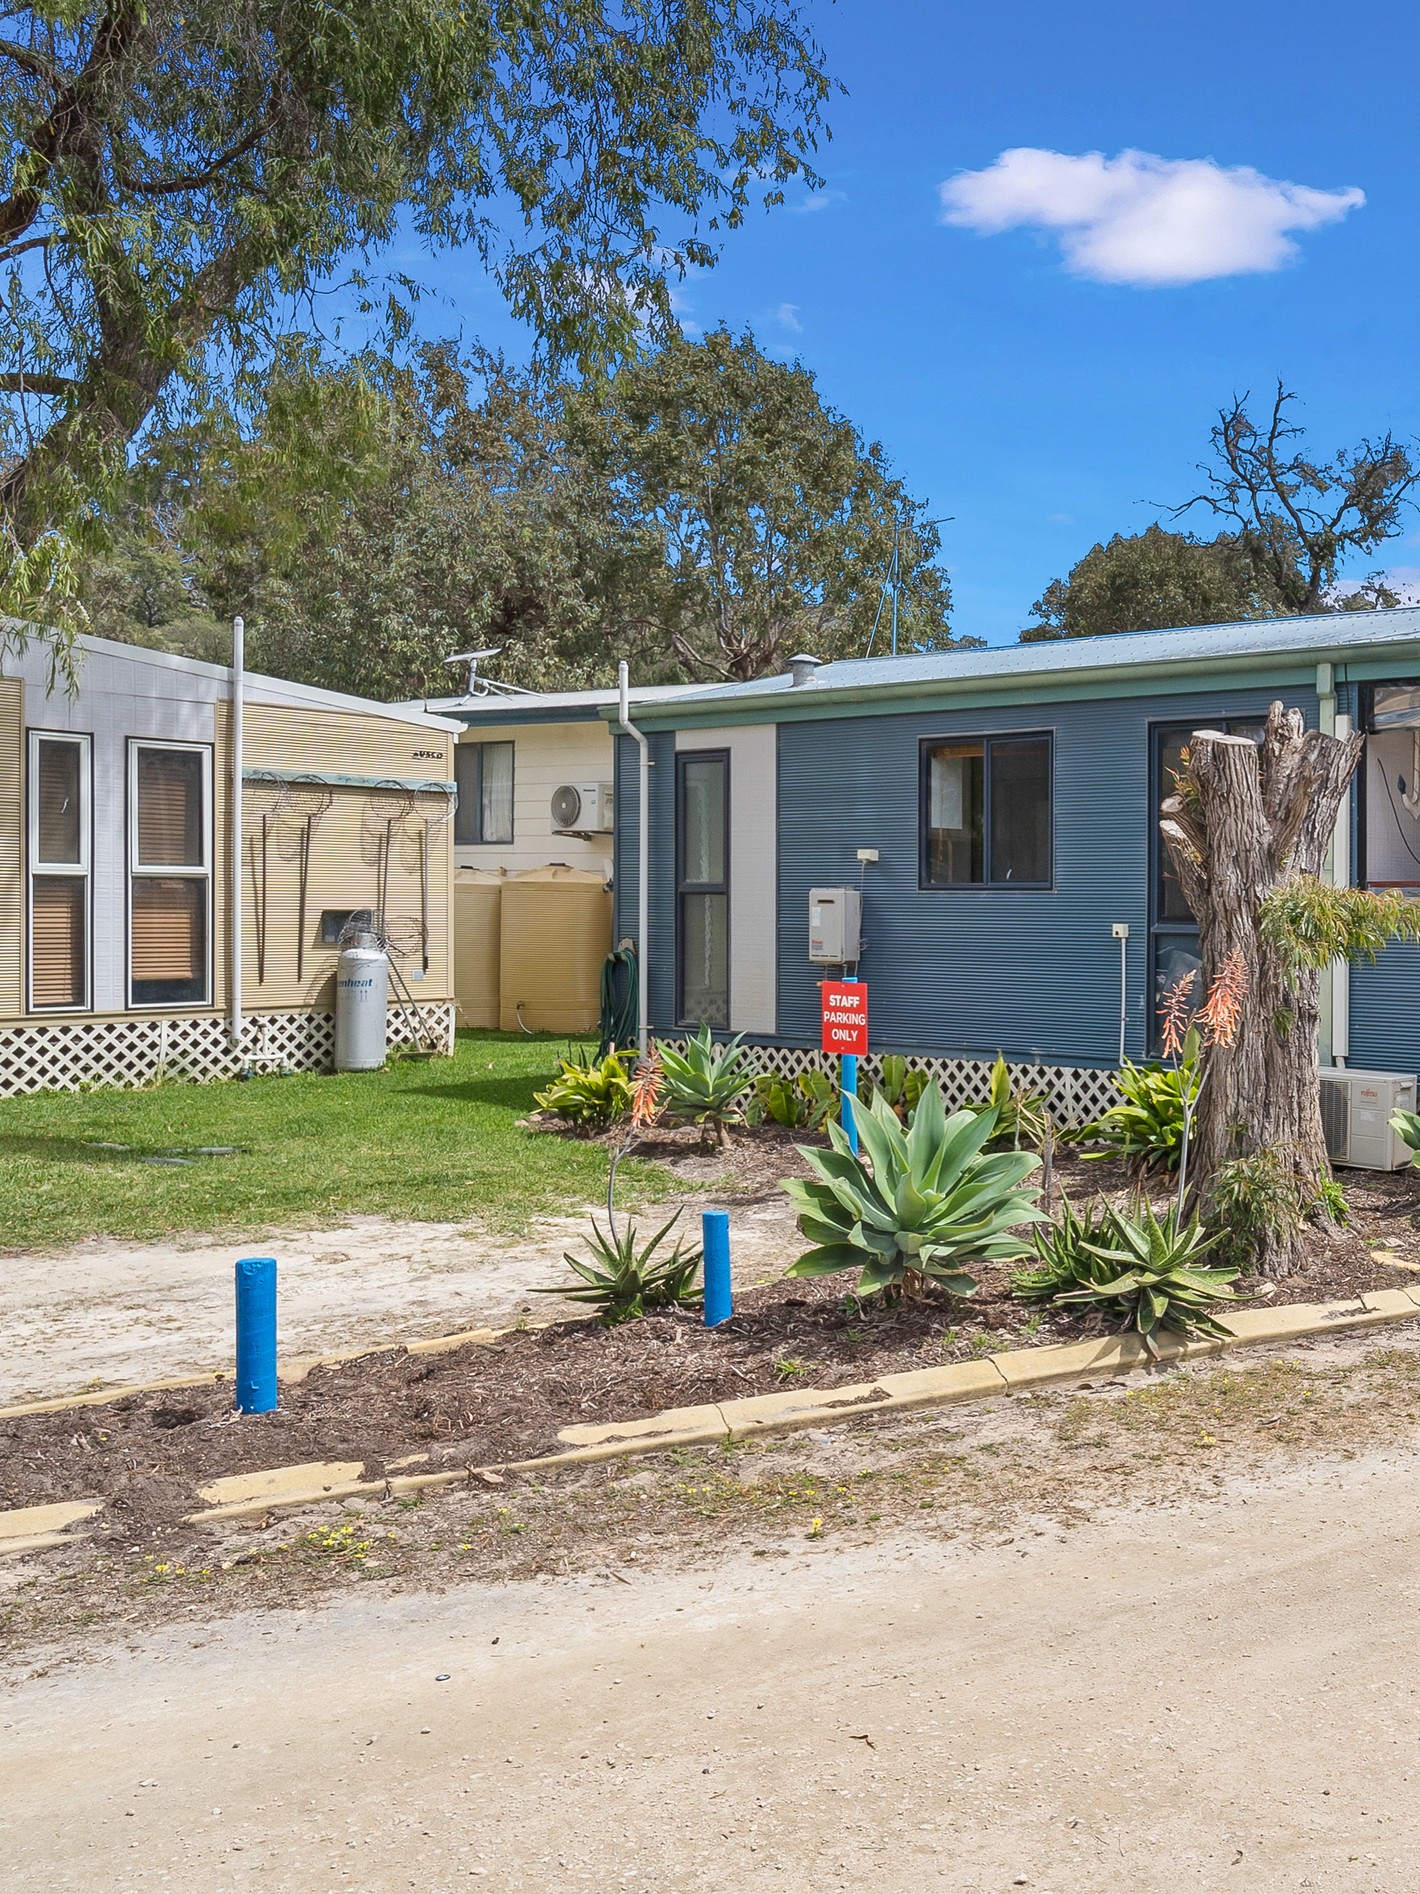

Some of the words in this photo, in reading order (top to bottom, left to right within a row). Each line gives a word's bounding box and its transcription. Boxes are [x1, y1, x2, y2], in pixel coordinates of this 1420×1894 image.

[829, 994, 860, 1008] STAFF
[823, 1011, 866, 1026] PARKING
[831, 1028, 858, 1042] ONLY
